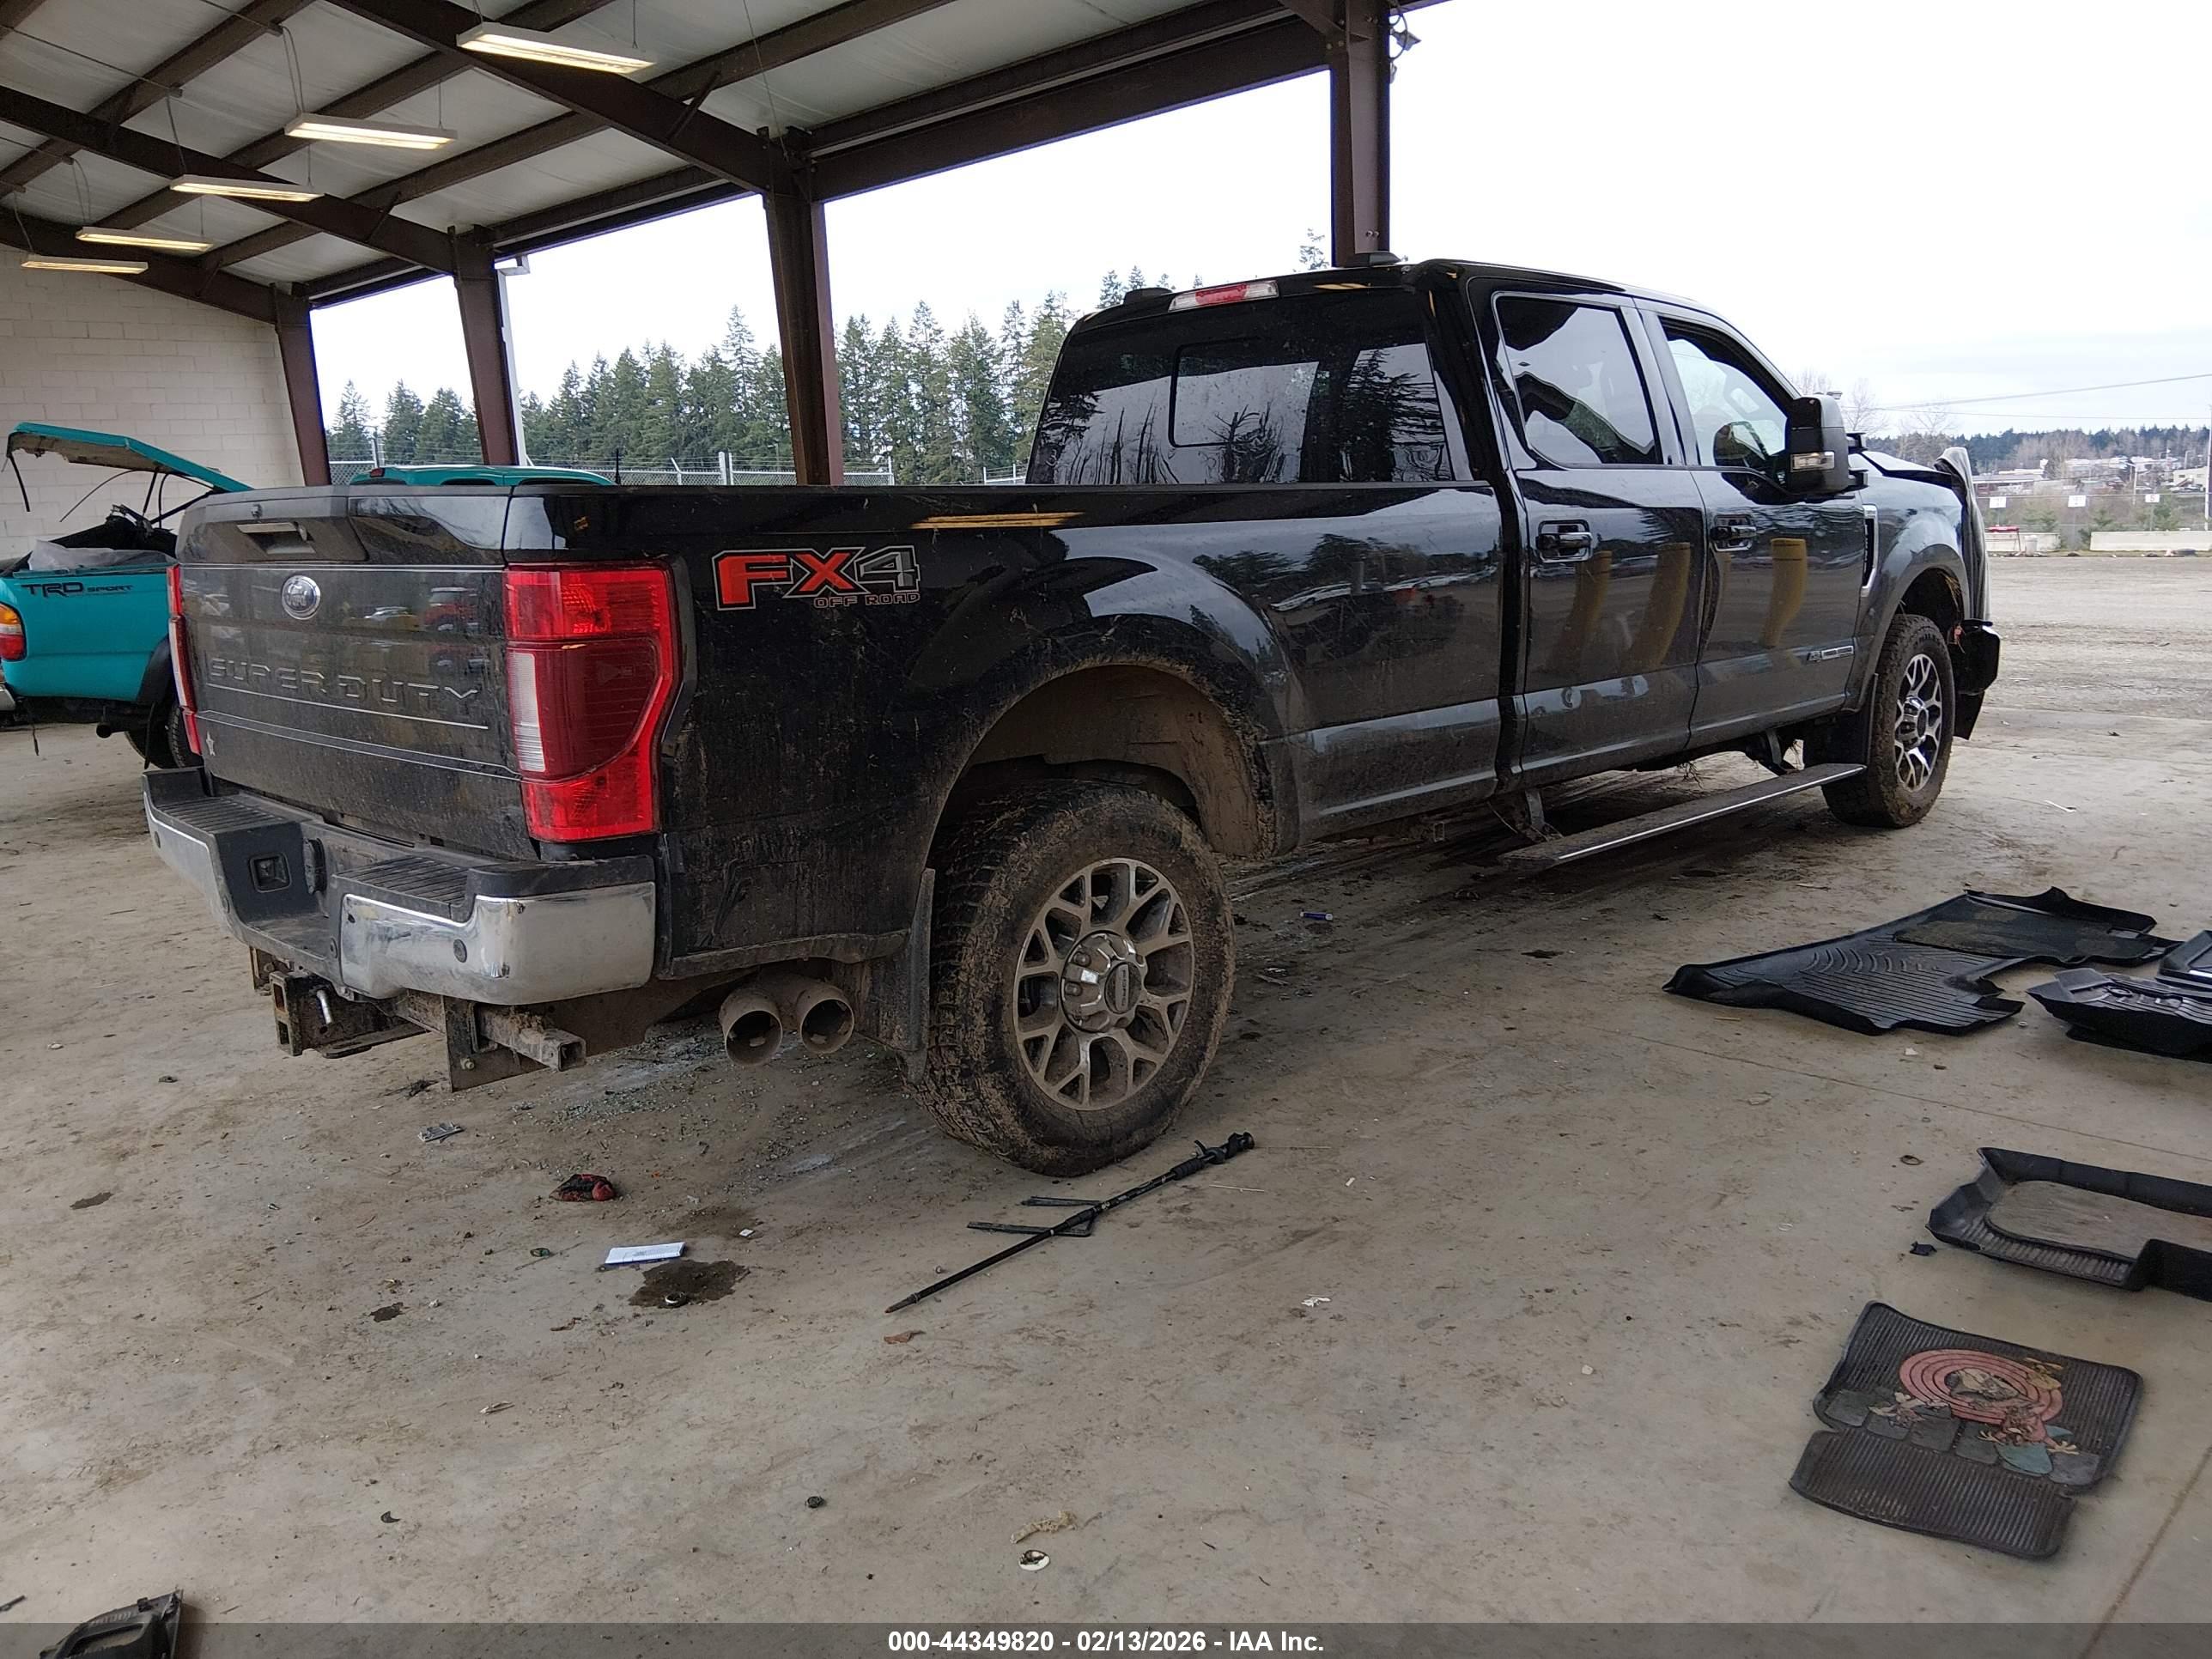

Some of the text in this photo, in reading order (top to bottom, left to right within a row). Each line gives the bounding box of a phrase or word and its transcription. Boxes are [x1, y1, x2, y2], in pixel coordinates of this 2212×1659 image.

[21, 581, 84, 599] TRD
[712, 545, 921, 611] FX4
[813, 592, 921, 609] OFF ROAD
[210, 657, 478, 714] SUPER DUTY
